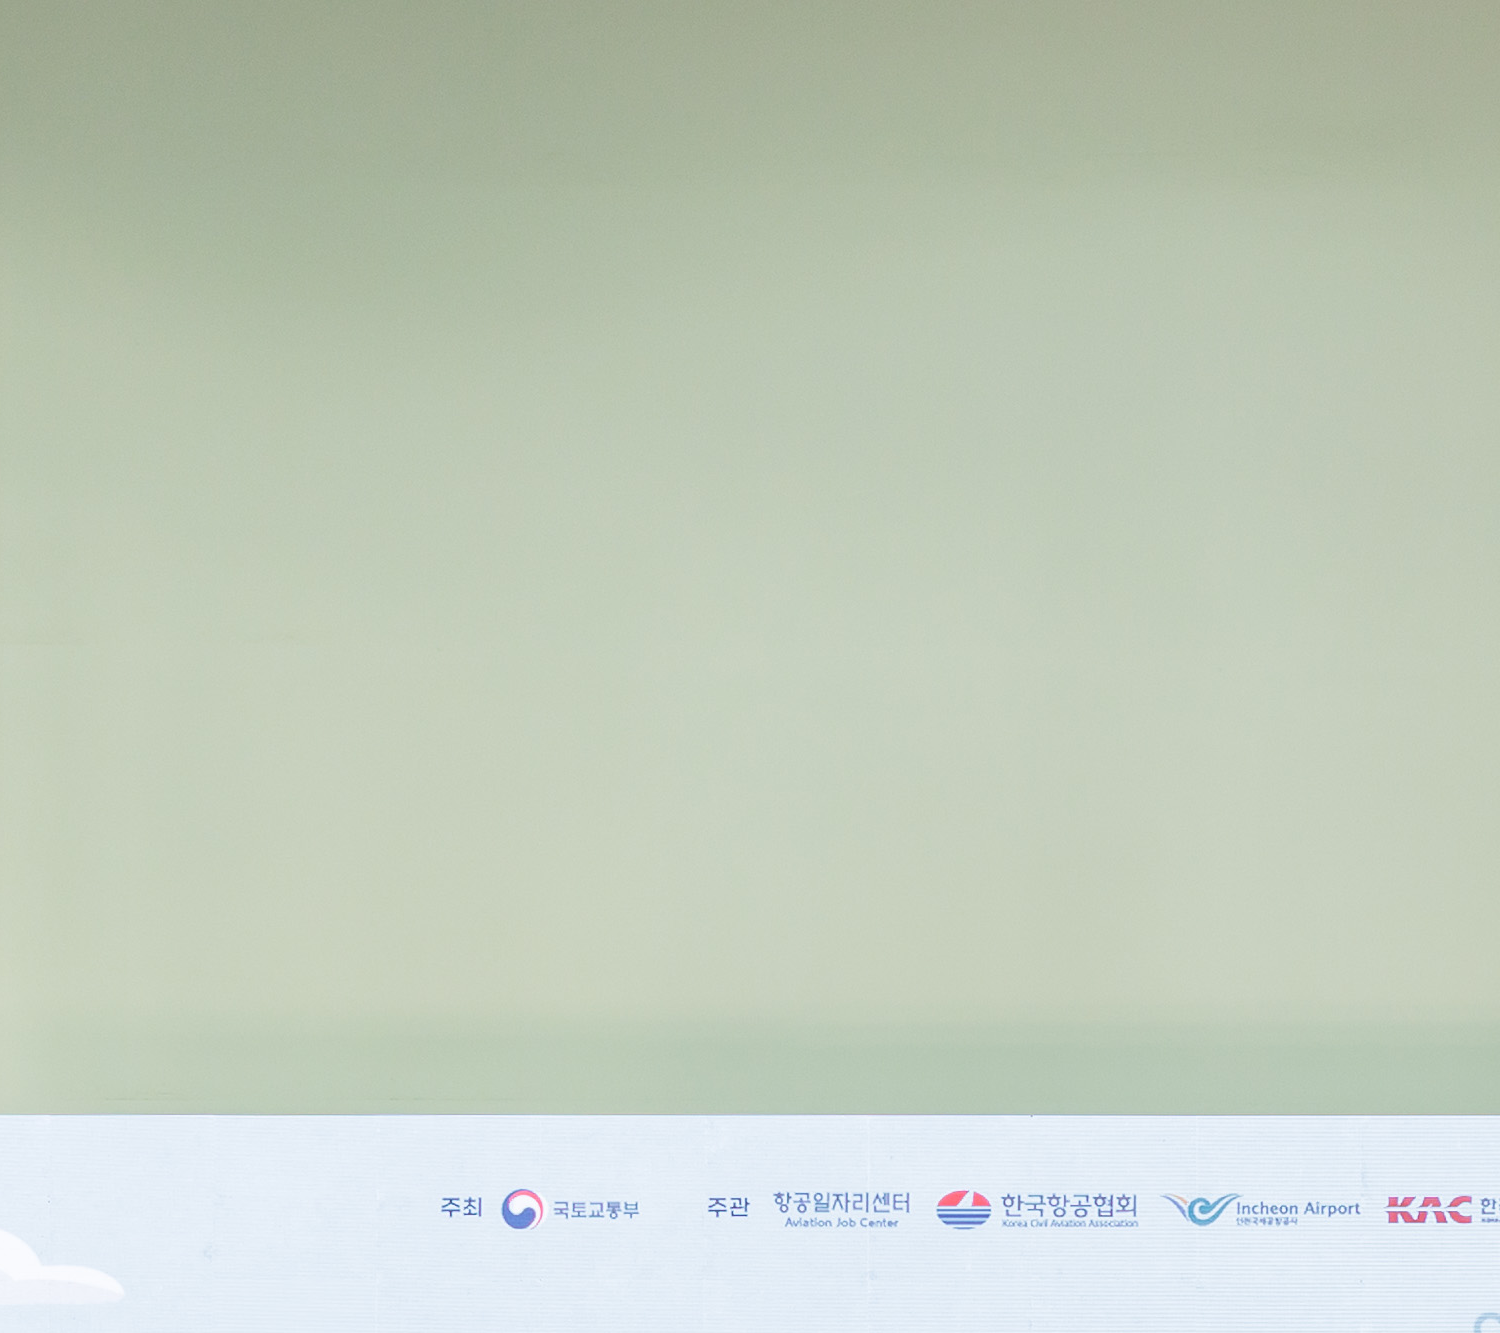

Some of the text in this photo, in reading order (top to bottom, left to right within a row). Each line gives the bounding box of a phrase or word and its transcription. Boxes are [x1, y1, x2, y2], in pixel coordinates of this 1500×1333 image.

[441, 1196, 483, 1218] 주최
[553, 1201, 640, 1219] 국토교통부
[708, 1196, 750, 1218] 주관
[773, 1191, 911, 1214] 항공일자리센터
[1001, 1193, 1137, 1218] 한국항공협회
[1237, 1201, 1361, 1217] Incheon Airport
[1388, 1196, 1472, 1224] KAC
[785, 1217, 899, 1229] Aviation Job Center
